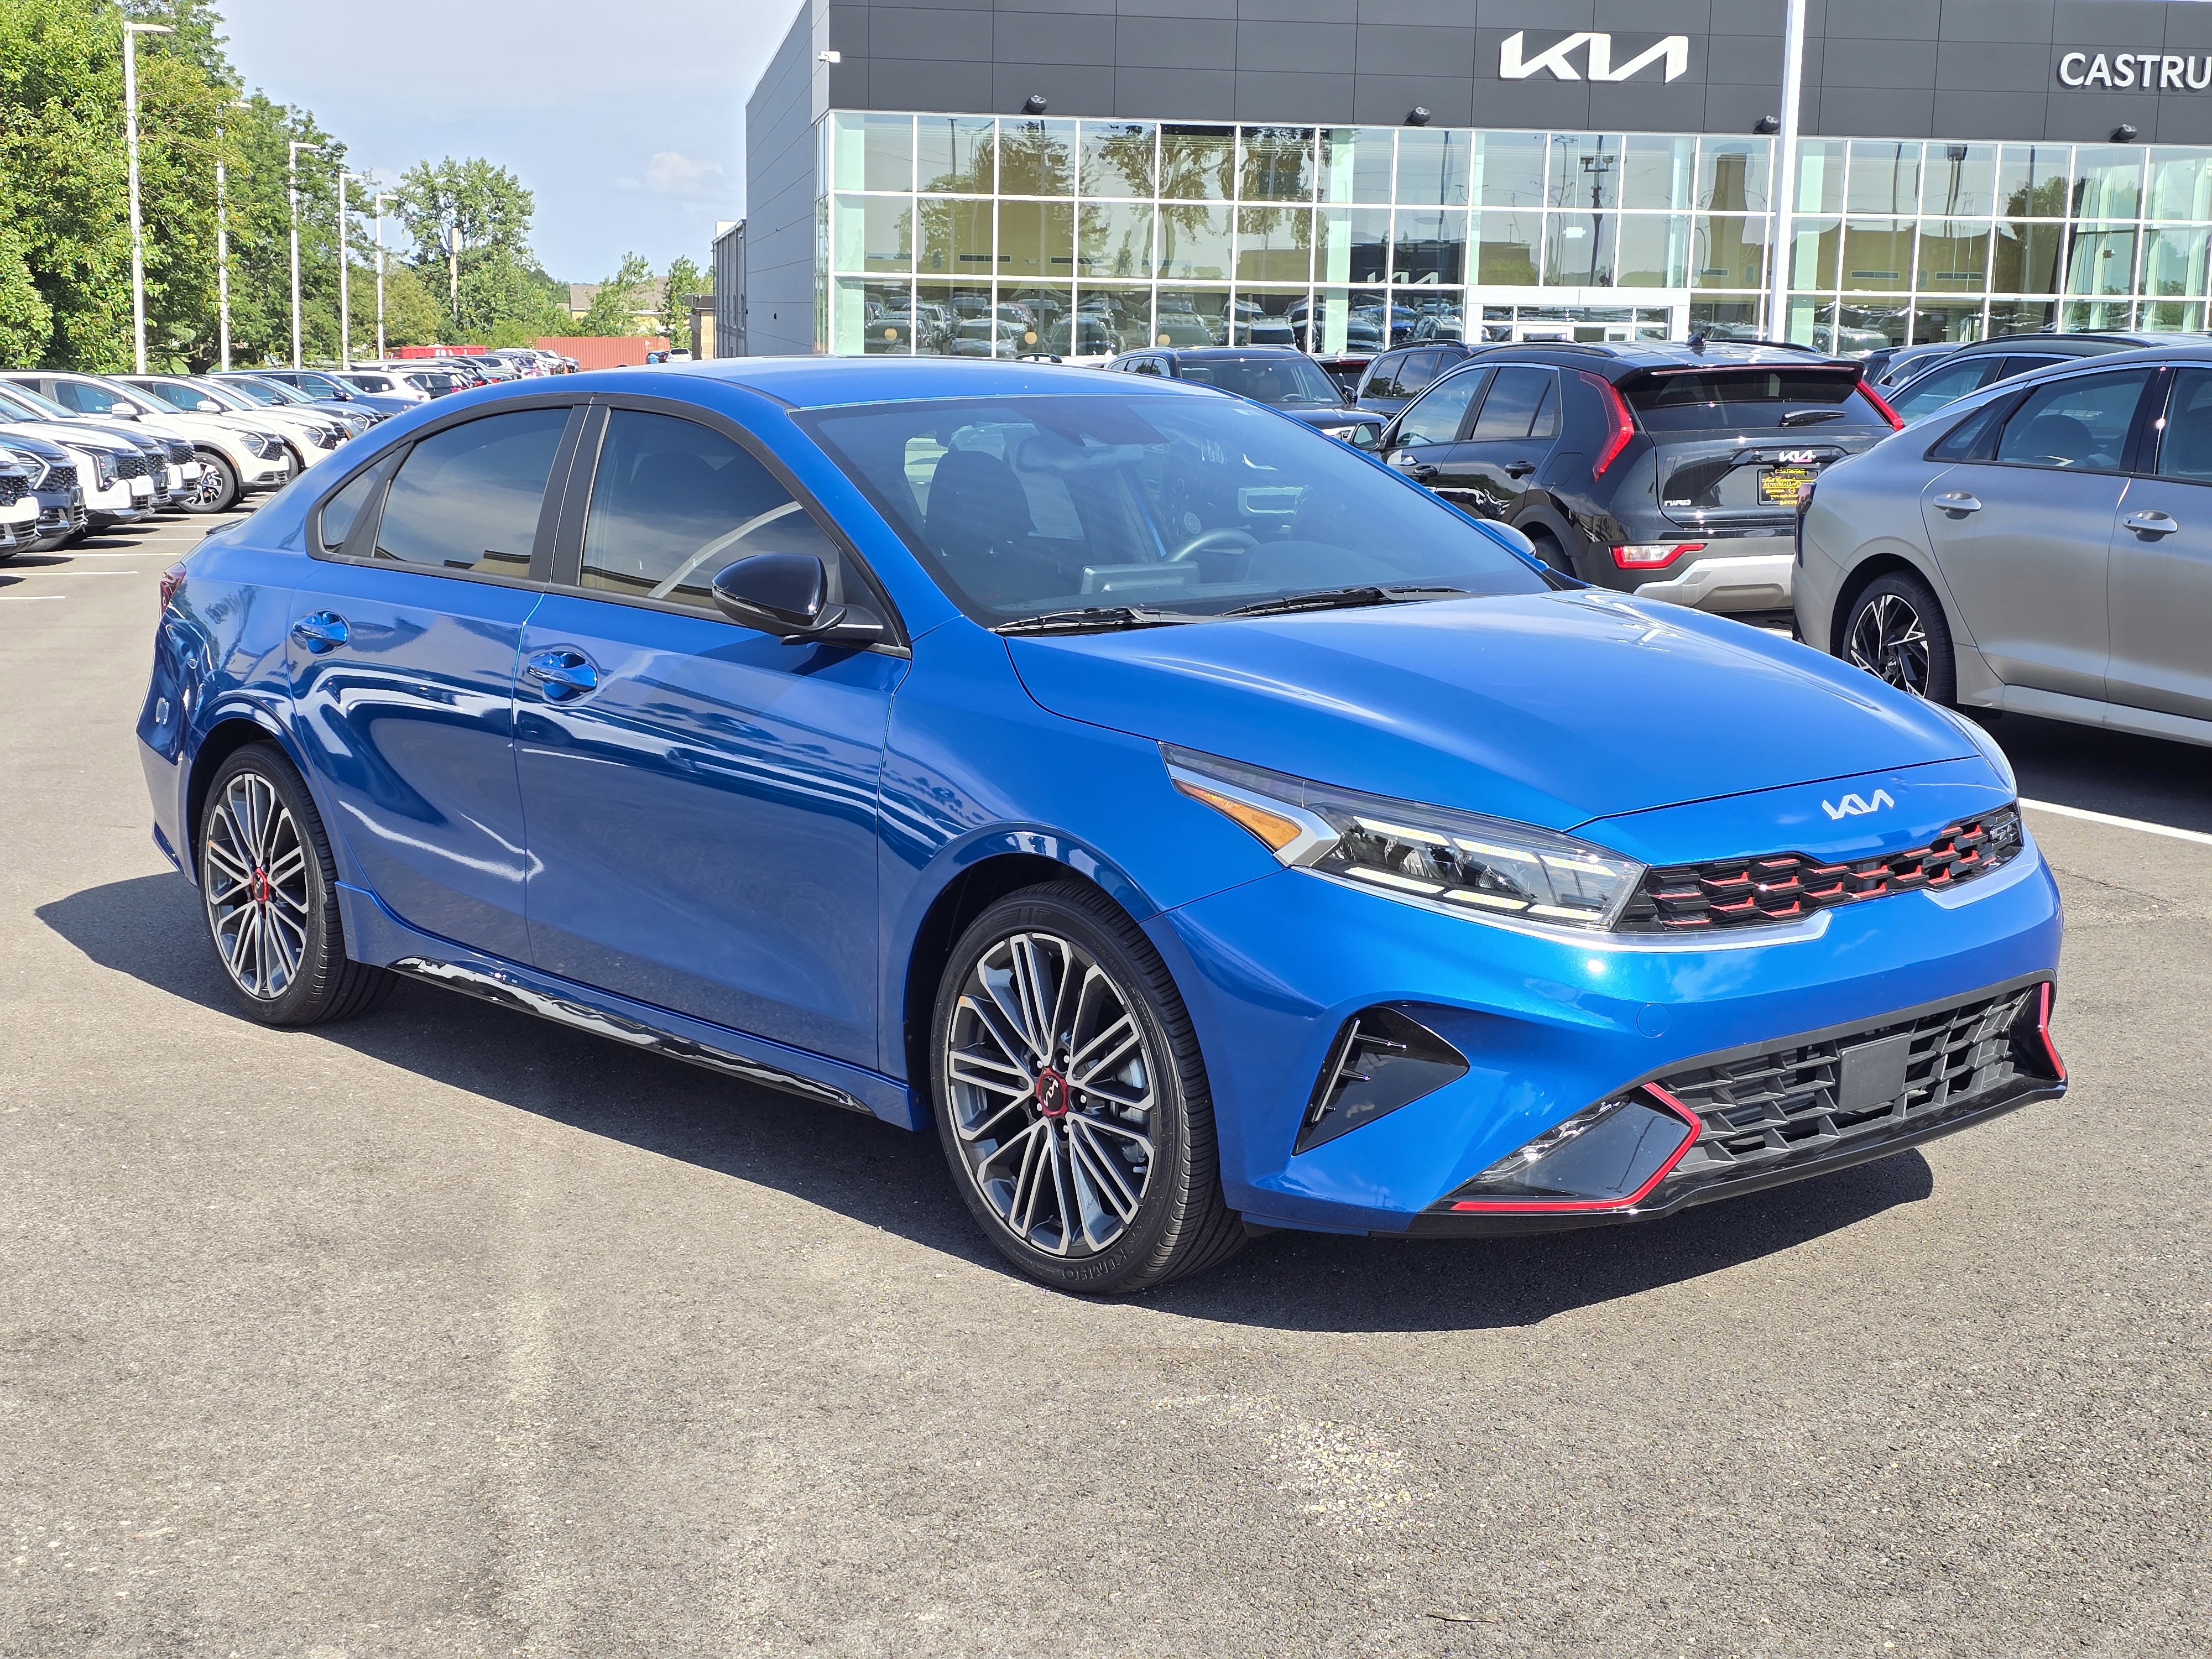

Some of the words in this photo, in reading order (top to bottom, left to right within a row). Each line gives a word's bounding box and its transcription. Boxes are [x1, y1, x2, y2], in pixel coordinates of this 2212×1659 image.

[1499, 30, 1689, 84] KIA
[2059, 52, 2212, 89] CASTRU
[1779, 450, 1813, 462] KIA
[1822, 789, 1895, 820] KIA
[1062, 1247, 1128, 1281] KUMHO
